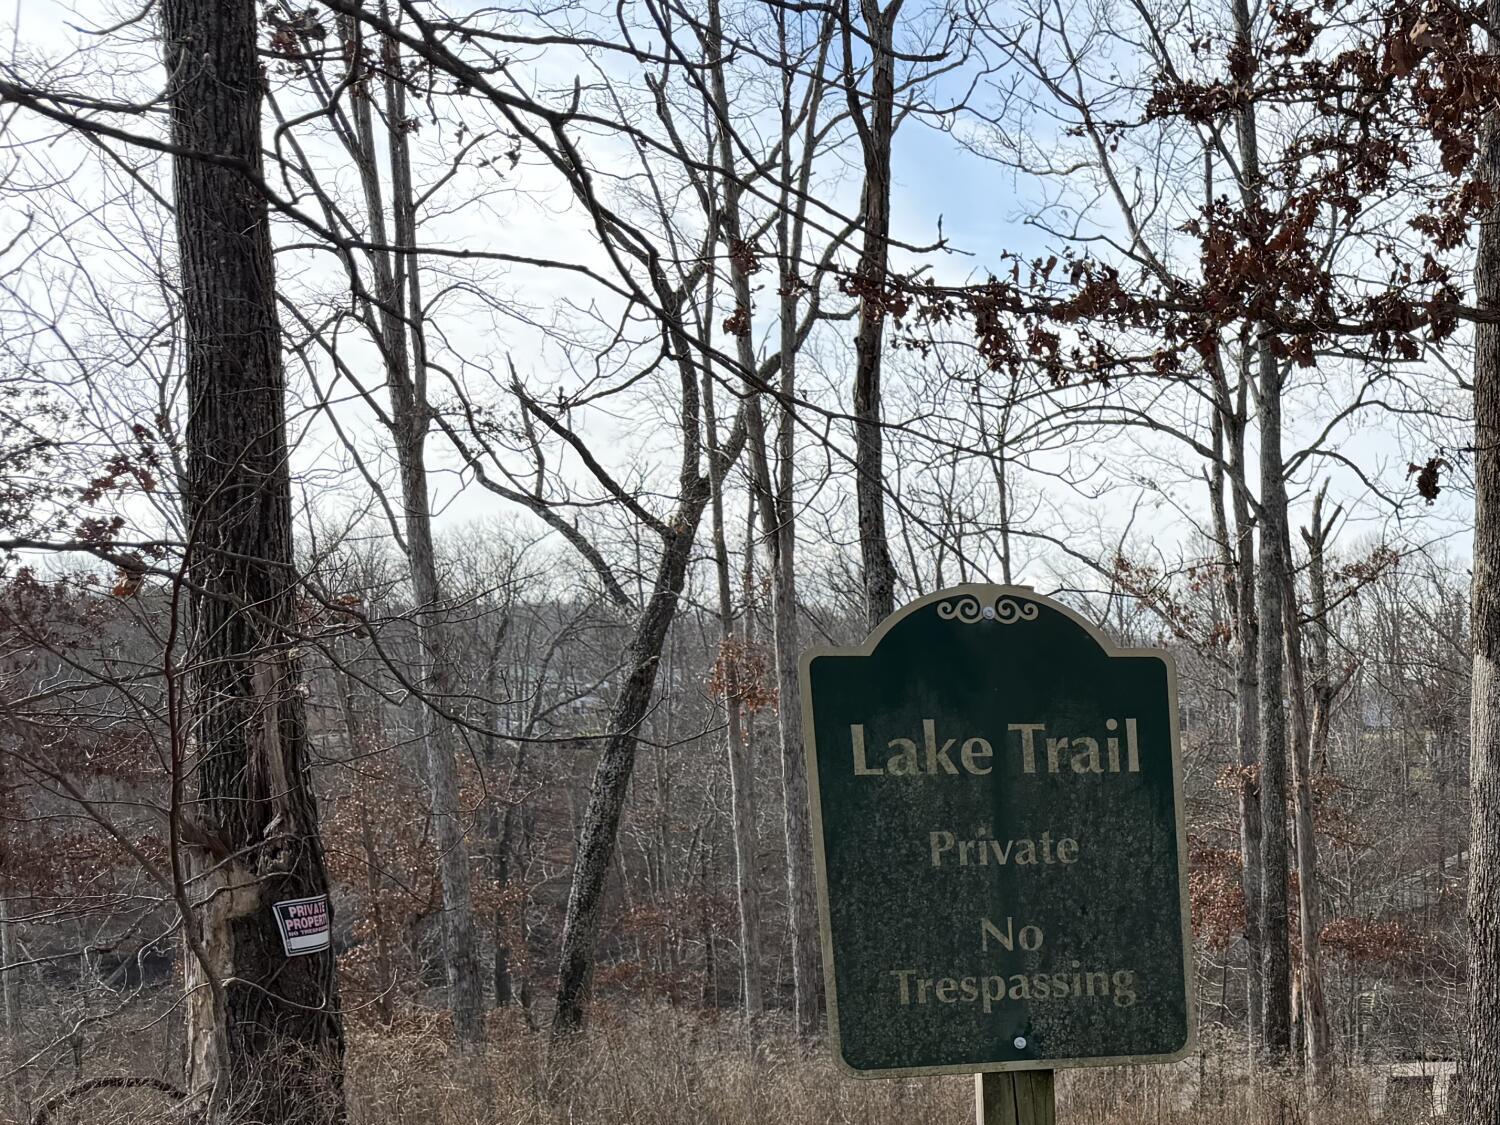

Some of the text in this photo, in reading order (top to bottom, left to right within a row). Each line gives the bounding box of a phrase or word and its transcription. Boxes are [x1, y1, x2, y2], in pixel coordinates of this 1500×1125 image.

[850, 718, 1140, 776] Lake Trail
[929, 828, 1080, 866] Private
[982, 917, 1044, 952] No
[890, 961, 1136, 1014] Trespassing
